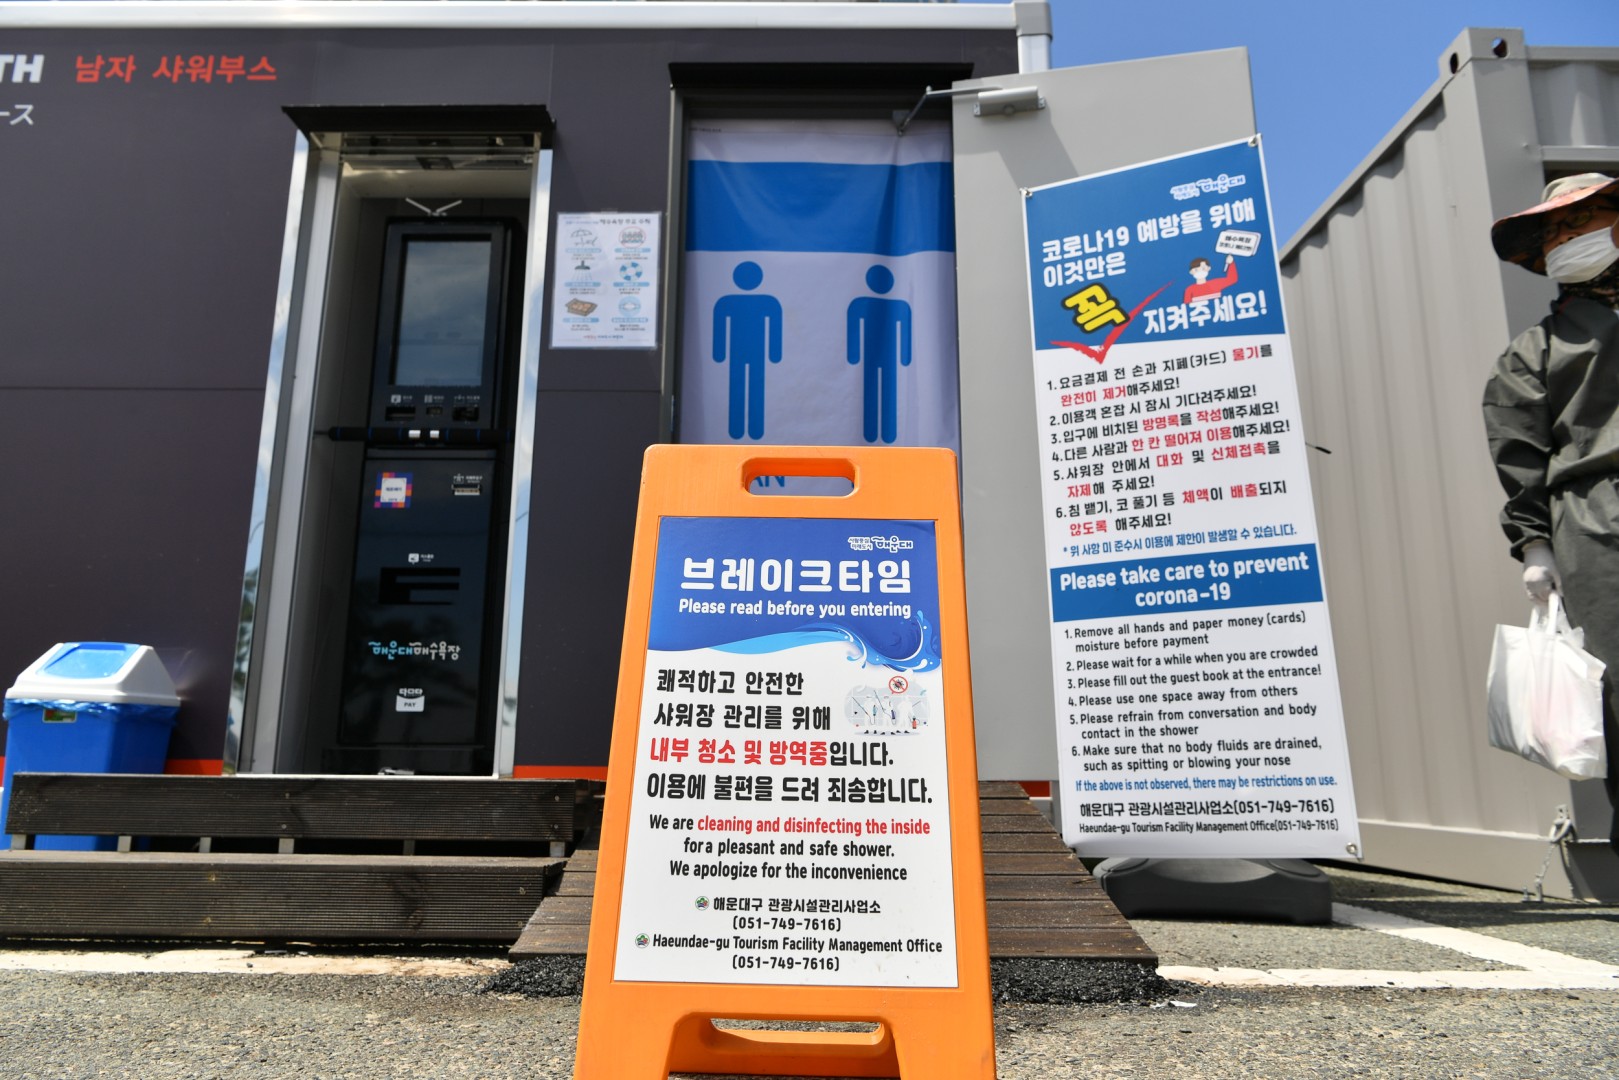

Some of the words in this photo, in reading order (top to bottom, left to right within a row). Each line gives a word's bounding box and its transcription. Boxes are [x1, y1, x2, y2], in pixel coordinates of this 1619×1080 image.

[75, 54, 137, 84] 남자
[152, 54, 278, 84] 샤워부스
[1196, 174, 1246, 194] 해운대
[1042, 225, 1129, 262] 코로나19
[1137, 209, 1202, 242] 예방을
[1209, 197, 1255, 228] 위해
[1043, 252, 1125, 287] 이것만은
[1062, 283, 1130, 333] 꼭
[1143, 290, 1268, 335] 지켜주세요!
[1059, 370, 1107, 389] 요금결제
[1132, 362, 1156, 377] 손과
[1162, 350, 1226, 371] 지폐(카드)
[1232, 343, 1272, 361] 물기를
[1061, 390, 1096, 406] 완전히
[1102, 376, 1179, 399] 제거해주세요!
[1100, 403, 1124, 418] 혼잡
[1145, 396, 1170, 412] 잠시
[1175, 384, 1256, 407] 기다려주세요!
[1102, 420, 1138, 436] 비치된
[1142, 412, 1191, 431] 방명록을
[1196, 401, 1279, 422] 작성해주세요!
[1091, 440, 1127, 456] 사람과
[1206, 419, 1289, 441] 이용해주세요!
[1066, 462, 1103, 479] 샤워장
[1111, 456, 1149, 473] 안에서
[1156, 452, 1182, 467] 대화
[1211, 440, 1280, 460] 신체접촉을
[1067, 481, 1104, 497] 자제해
[1112, 475, 1154, 492] 주세요!
[1084, 500, 1112, 515] 뱉기,
[1133, 494, 1157, 509] 풀기
[1182, 486, 1222, 503] 체액이
[1230, 480, 1286, 498] 배출되지
[1069, 519, 1106, 536] 않도록
[1115, 512, 1171, 530] 해주세요!
[871, 536, 914, 553] 해운대
[1082, 542, 1099, 554] 사항
[1114, 538, 1142, 552] 준수시
[1144, 534, 1173, 548] 이용에
[1175, 531, 1205, 545] 제한이
[1207, 528, 1237, 543] 발생할
[1252, 523, 1296, 538] 있습니다.
[680, 557, 911, 594] 브레이크타임
[1060, 571, 1116, 591] Please
[1119, 565, 1160, 584] take
[1164, 564, 1204, 581] care
[1208, 559, 1229, 577] to
[1233, 551, 1309, 578] prevent
[678, 598, 725, 613] Please
[730, 599, 762, 614] read
[767, 599, 814, 615] before
[818, 604, 845, 618] you
[850, 601, 911, 619] entering
[1074, 627, 1113, 637] Remove
[1133, 621, 1164, 633] hands
[1192, 619, 1222, 631] paper
[1227, 616, 1263, 627] money
[1266, 610, 1305, 625] (cards)
[1075, 640, 1119, 652] moisture
[1123, 637, 1157, 648] before
[1162, 633, 1208, 648] payment
[1076, 659, 1108, 670] Please
[1111, 656, 1134, 668] wait
[1163, 653, 1191, 665] while
[1269, 645, 1318, 658] crowded
[656, 668, 734, 693] 쾌적하고
[745, 671, 803, 695] 안전한
[1077, 677, 1110, 688] Please
[1170, 671, 1200, 685] guest
[1202, 669, 1229, 681] book
[1267, 663, 1321, 677] entrance!
[1078, 695, 1111, 705] Please
[1161, 692, 1192, 703] space
[1197, 690, 1224, 701] away
[1261, 685, 1297, 697] others
[653, 702, 714, 727] 샤워장
[723, 704, 782, 729] 관리를
[791, 705, 830, 730] 위해
[1080, 713, 1113, 723] Please
[1117, 710, 1153, 722] refrain
[1157, 709, 1183, 720] from
[1188, 705, 1259, 719] conversation
[1288, 702, 1316, 716] body
[1081, 727, 1120, 739] contact
[1159, 724, 1198, 736] shower
[650, 737, 688, 762] 내부
[697, 738, 735, 763] 청소
[743, 739, 761, 764] 및
[769, 740, 893, 766] 방역중입니다.
[1082, 744, 1109, 755] Make
[1114, 745, 1136, 754] sure
[1141, 742, 1163, 753] that
[1185, 740, 1212, 753] body
[1216, 739, 1248, 751] fluids
[1274, 736, 1321, 749] drained,
[1083, 759, 1107, 771] such
[1127, 757, 1168, 772] spitting
[1187, 756, 1230, 769] blowing
[1263, 756, 1290, 765] nose
[646, 772, 706, 799] 이용에
[713, 774, 772, 801] 불편을
[781, 776, 818, 802] 드려
[827, 776, 932, 803] 죄송합니다.
[1099, 779, 1123, 790] above
[1149, 777, 1191, 789] observed,
[1192, 777, 1216, 788] there
[1251, 774, 1303, 787] restrictions
[1318, 776, 1336, 785] use.
[1080, 802, 1124, 816] 해운대구
[649, 813, 668, 829] We
[672, 817, 693, 830] are
[697, 814, 752, 834] cleaning
[756, 816, 780, 832] and
[783, 816, 861, 836] disinfecting
[865, 818, 887, 834] the
[891, 818, 930, 834] inside
[1079, 822, 1130, 834] Haeundae-gu
[1131, 822, 1163, 832] Tourism
[1164, 821, 1193, 833] Facility
[1195, 820, 1248, 833] Management
[717, 838, 775, 856] pleasant
[779, 839, 803, 855] and
[809, 839, 837, 856] safe
[843, 840, 894, 856] shower.
[669, 859, 689, 876] We
[693, 860, 757, 880] apologize
[761, 861, 781, 878] for
[784, 862, 807, 878] the
[811, 862, 907, 880] inconvenience
[713, 896, 762, 911] 해운대구
[767, 898, 880, 913] 관광시설관리사업소
[732, 915, 840, 932] (051-749-7616)
[652, 933, 729, 951] Haeundae-gu
[732, 935, 778, 949] Tourism
[782, 936, 824, 953] Facility
[828, 937, 902, 953] Management
[906, 938, 942, 952] Office
[732, 954, 839, 971] (051-749-7616)
